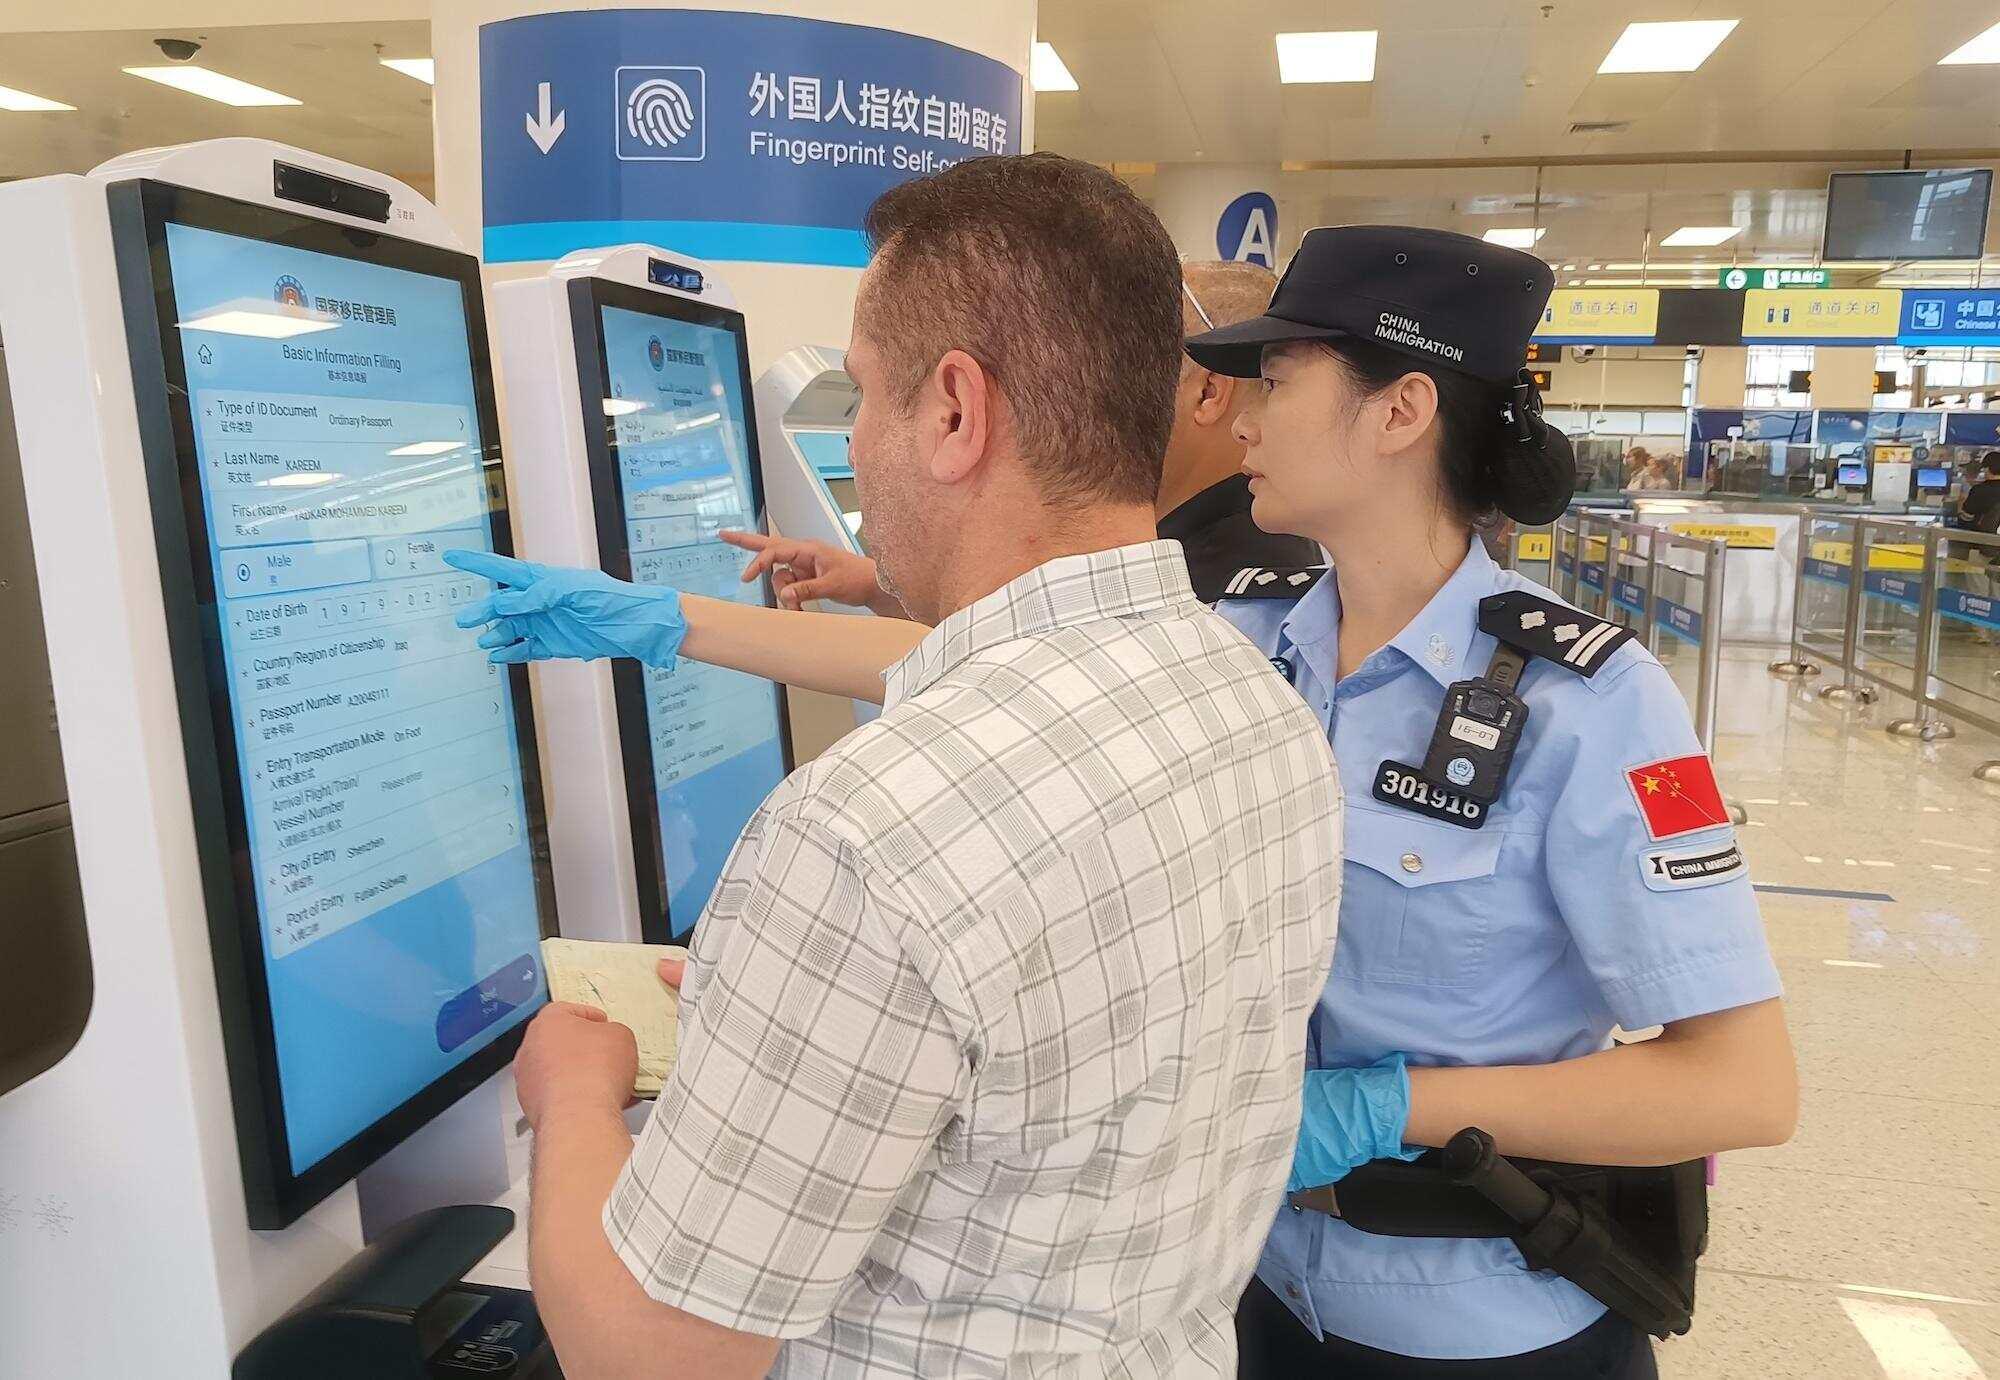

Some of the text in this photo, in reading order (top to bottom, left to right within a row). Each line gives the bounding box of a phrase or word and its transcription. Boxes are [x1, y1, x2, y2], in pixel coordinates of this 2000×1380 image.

[749, 72, 1007, 155] 外国人指纹自助留存
[751, 131, 886, 167] Fingerprint
[1233, 208, 1273, 268] A
[315, 297, 397, 327] 国家移民管理局
[1957, 300, 2000, 317] 中国
[1379, 313, 1421, 335] CHINA
[1374, 324, 1465, 363] IMMIGRATION
[283, 344, 402, 373] Basic Information Filling
[218, 400, 318, 418] Type of ID Document
[361, 416, 393, 428] Passport
[225, 452, 280, 465] Last Name
[285, 460, 321, 471] KAREEM
[233, 504, 287, 517] First Name
[408, 542, 435, 554] Female
[267, 554, 292, 568] Male
[246, 602, 308, 623] Date of Birth
[253, 636, 386, 672] Country/Region of Citizenship
[260, 693, 342, 722] Passport Number
[266, 729, 385, 773] Entry Transportation Mode
[1381, 770, 1480, 819] 301916
[308, 800, 345, 820] Number
[280, 861, 299, 878] City
[312, 848, 336, 865] Entry
[1671, 863, 1704, 876] CHINA
[320, 894, 343, 911] Entry
